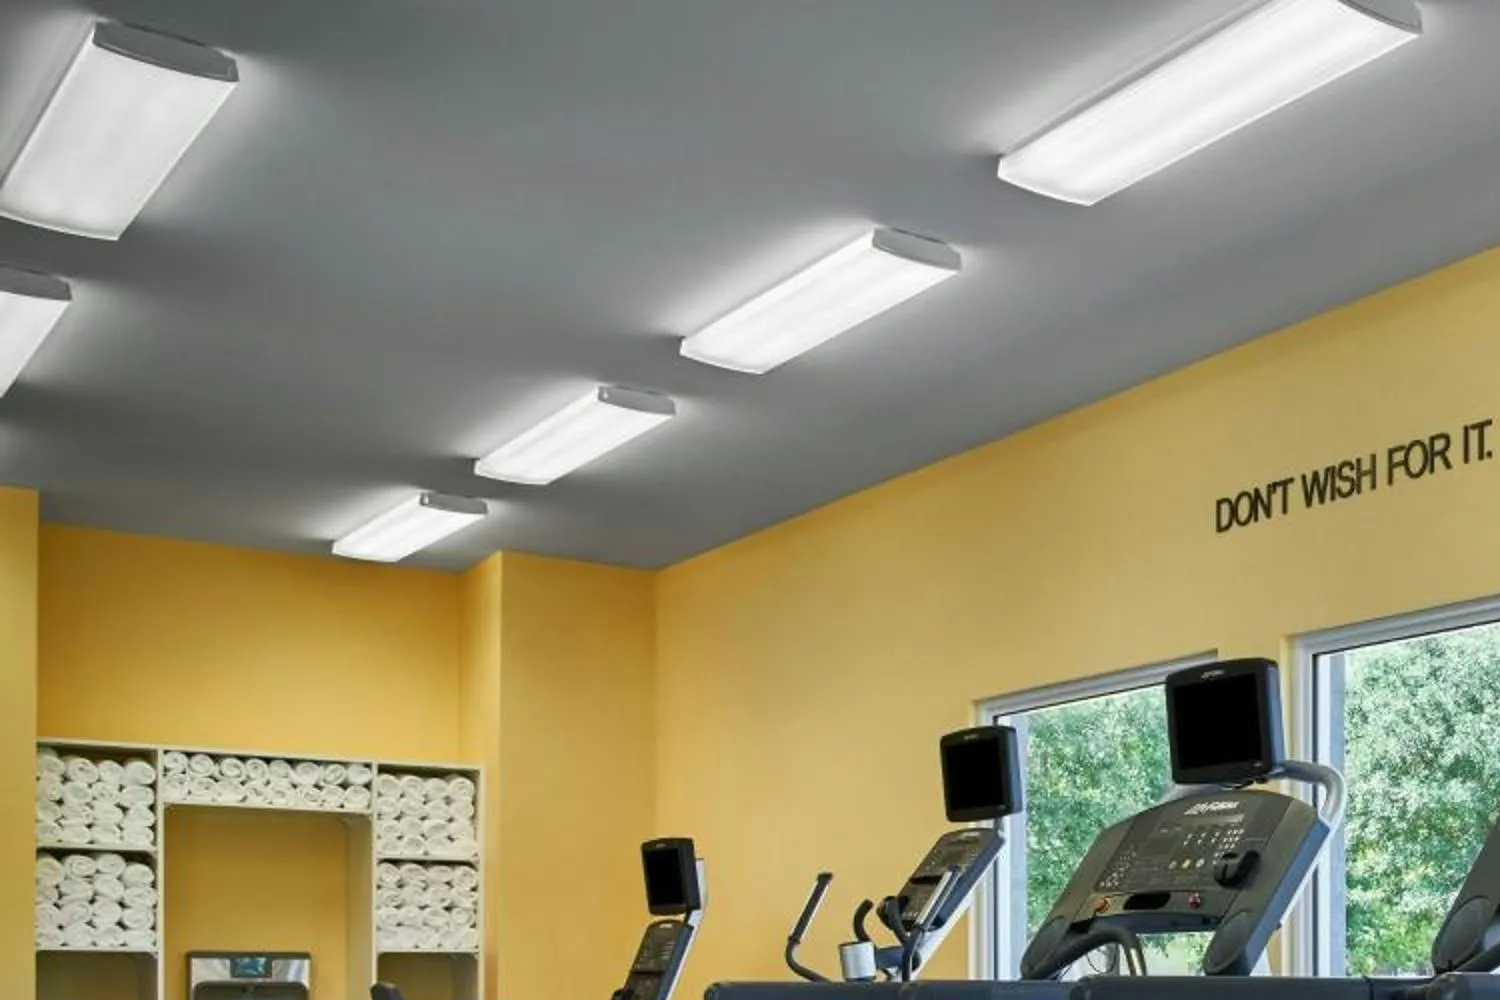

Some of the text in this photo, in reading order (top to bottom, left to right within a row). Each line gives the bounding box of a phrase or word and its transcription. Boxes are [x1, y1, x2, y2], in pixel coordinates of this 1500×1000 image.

[1215, 477, 1294, 532] DON'T
[1301, 453, 1377, 508] WISH
[1386, 432, 1451, 486] FOR
[1462, 418, 1494, 464] IT.
